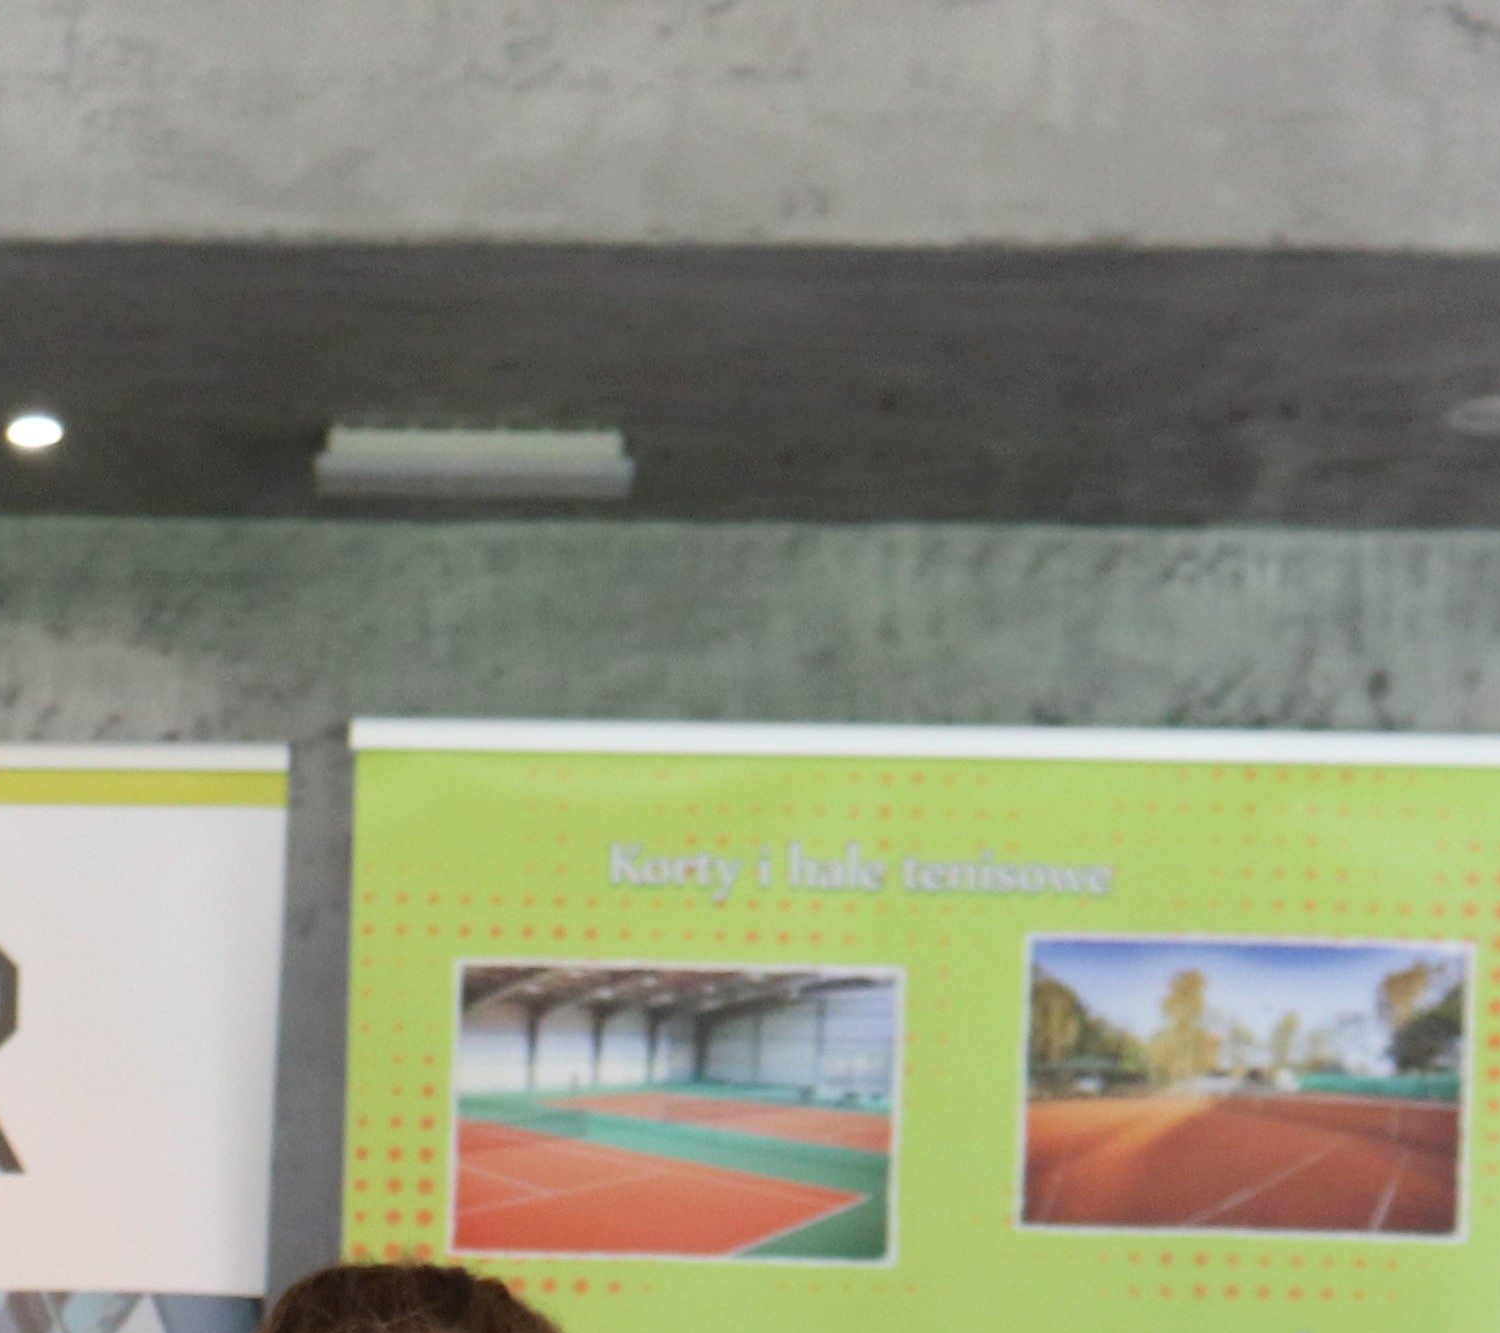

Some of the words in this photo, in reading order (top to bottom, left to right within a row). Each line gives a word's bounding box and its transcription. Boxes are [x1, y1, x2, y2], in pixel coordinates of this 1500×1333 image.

[608, 842, 742, 905] Korty
[757, 847, 772, 888] i
[787, 841, 887, 891] hale
[902, 849, 1114, 895] tenisowe
